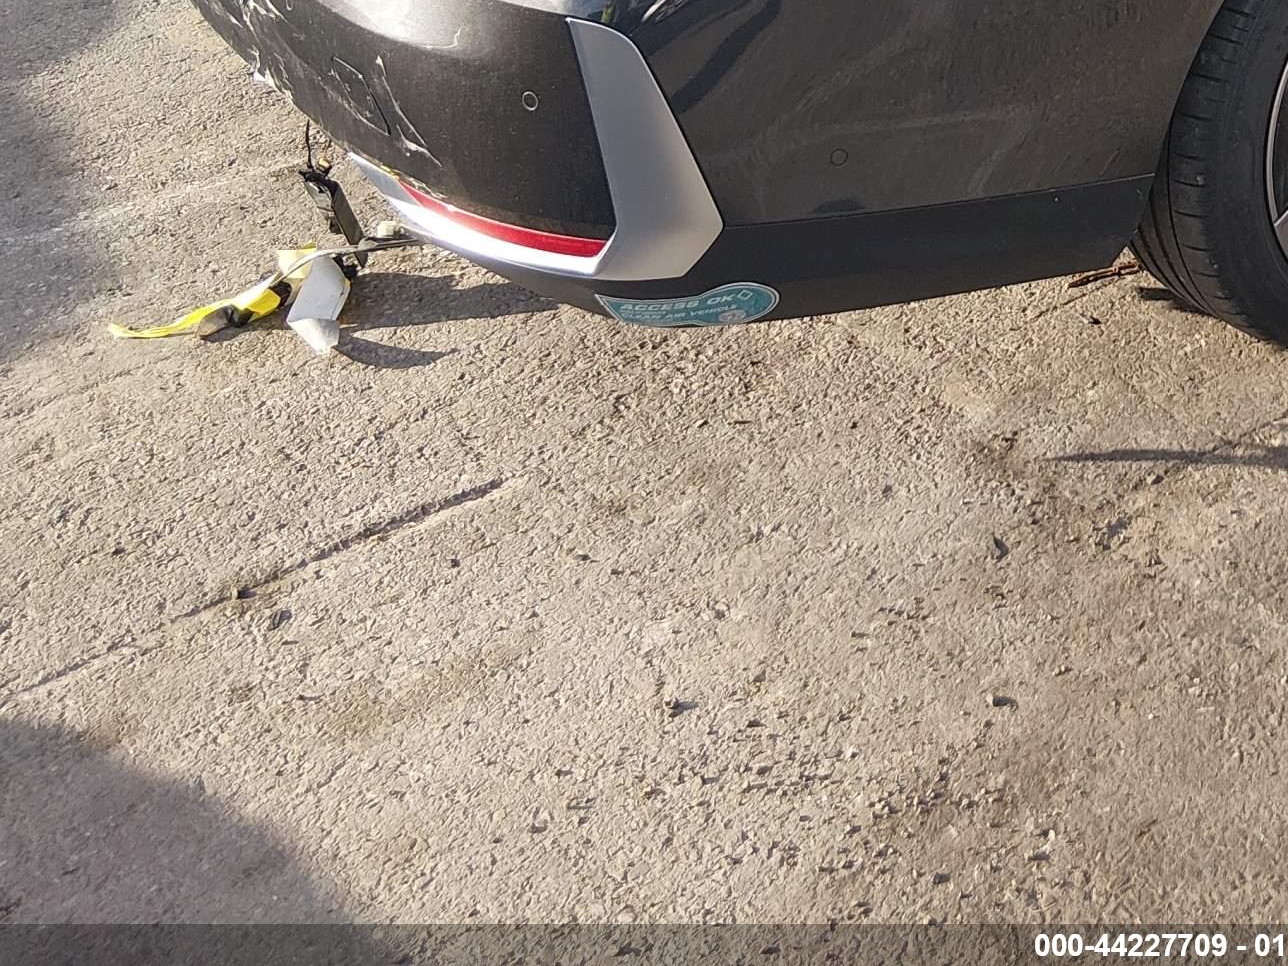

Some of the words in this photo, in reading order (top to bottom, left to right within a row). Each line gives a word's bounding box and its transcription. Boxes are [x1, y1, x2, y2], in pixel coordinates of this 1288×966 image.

[619, 300, 699, 312] ACCESS
[706, 293, 736, 305] OK
[665, 311, 686, 319] AIR
